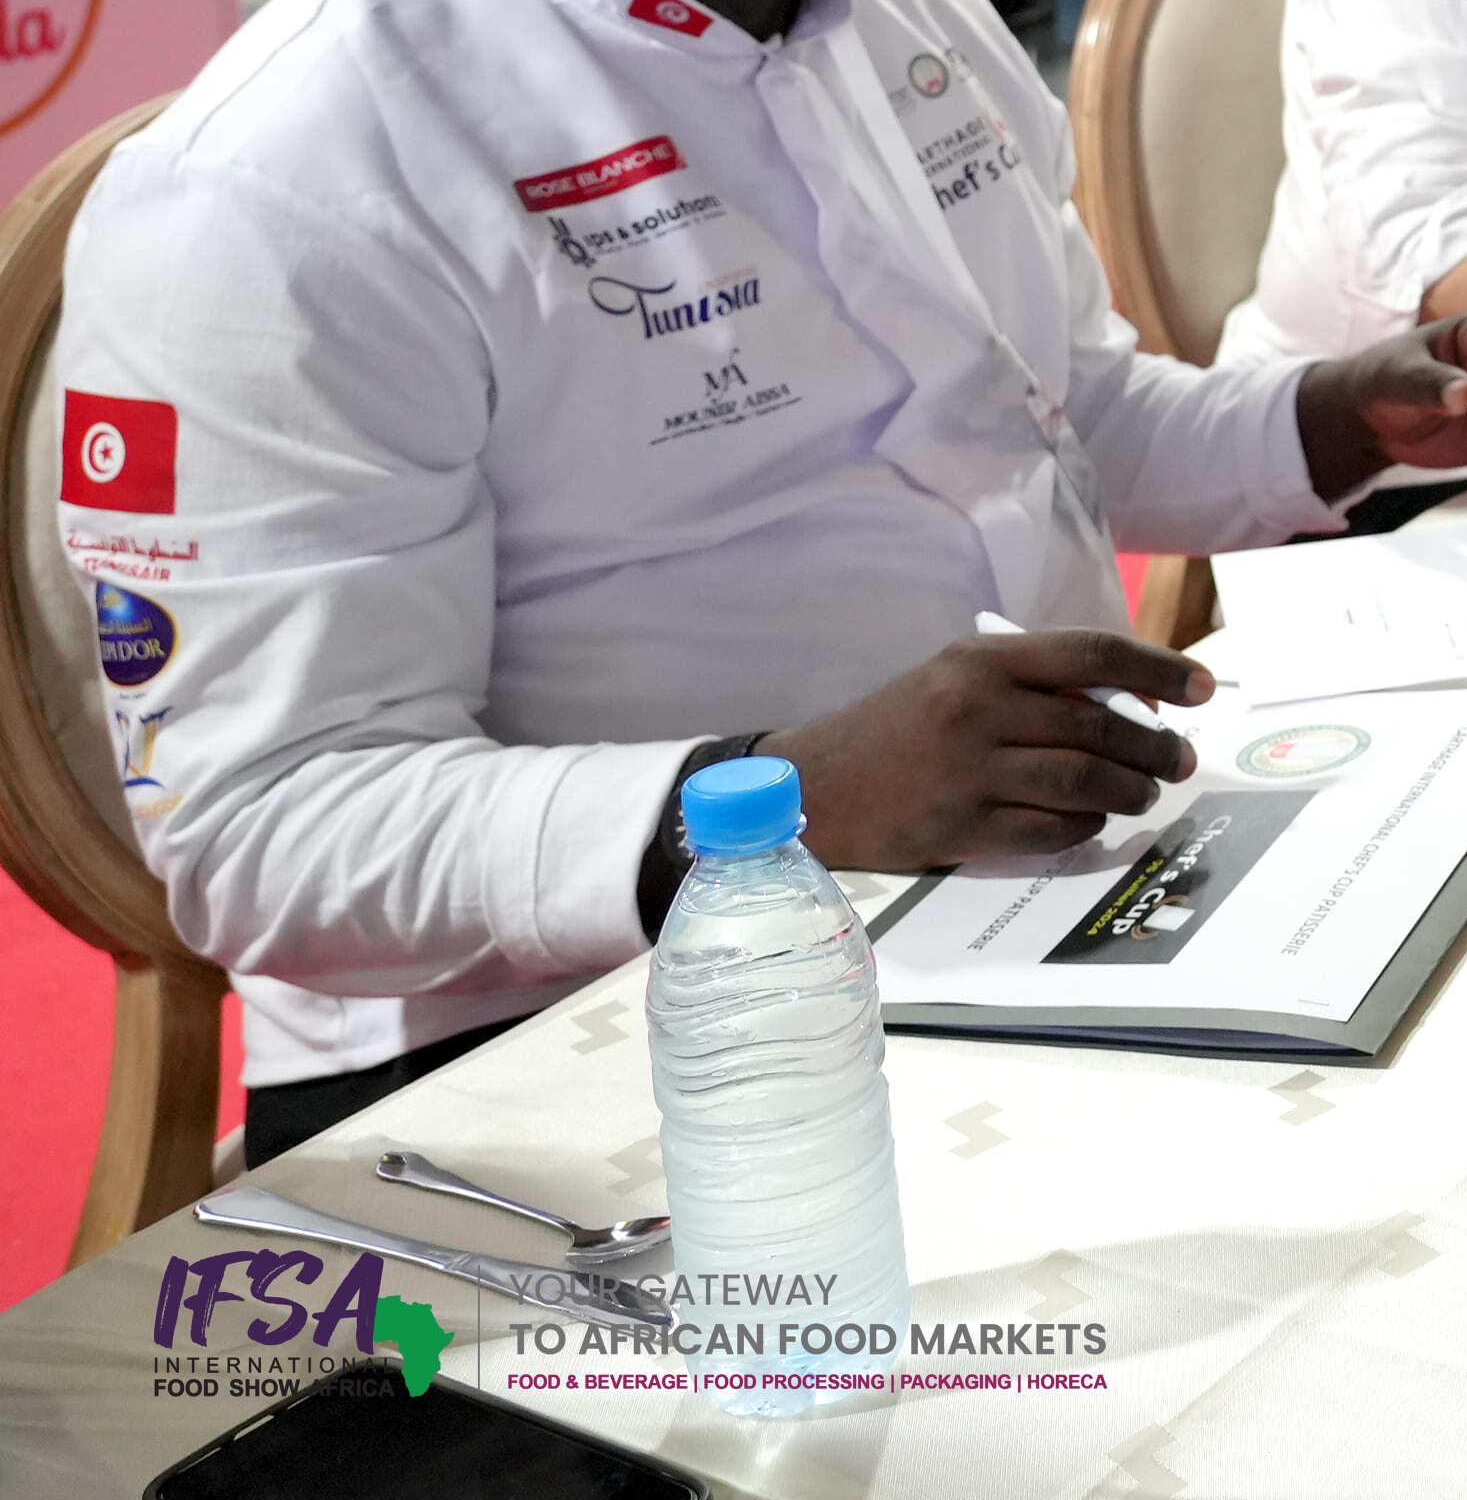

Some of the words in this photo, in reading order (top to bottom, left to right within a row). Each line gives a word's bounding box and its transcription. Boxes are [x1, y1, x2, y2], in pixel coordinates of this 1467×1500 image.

[525, 175, 577, 199] ROSE
[575, 142, 676, 188] BLANCHE
[1370, 771, 1435, 842] INTERNATIONAL
[1160, 815, 1232, 883] Chef's
[1112, 887, 1166, 935] Cup
[1330, 876, 1353, 898] CUP
